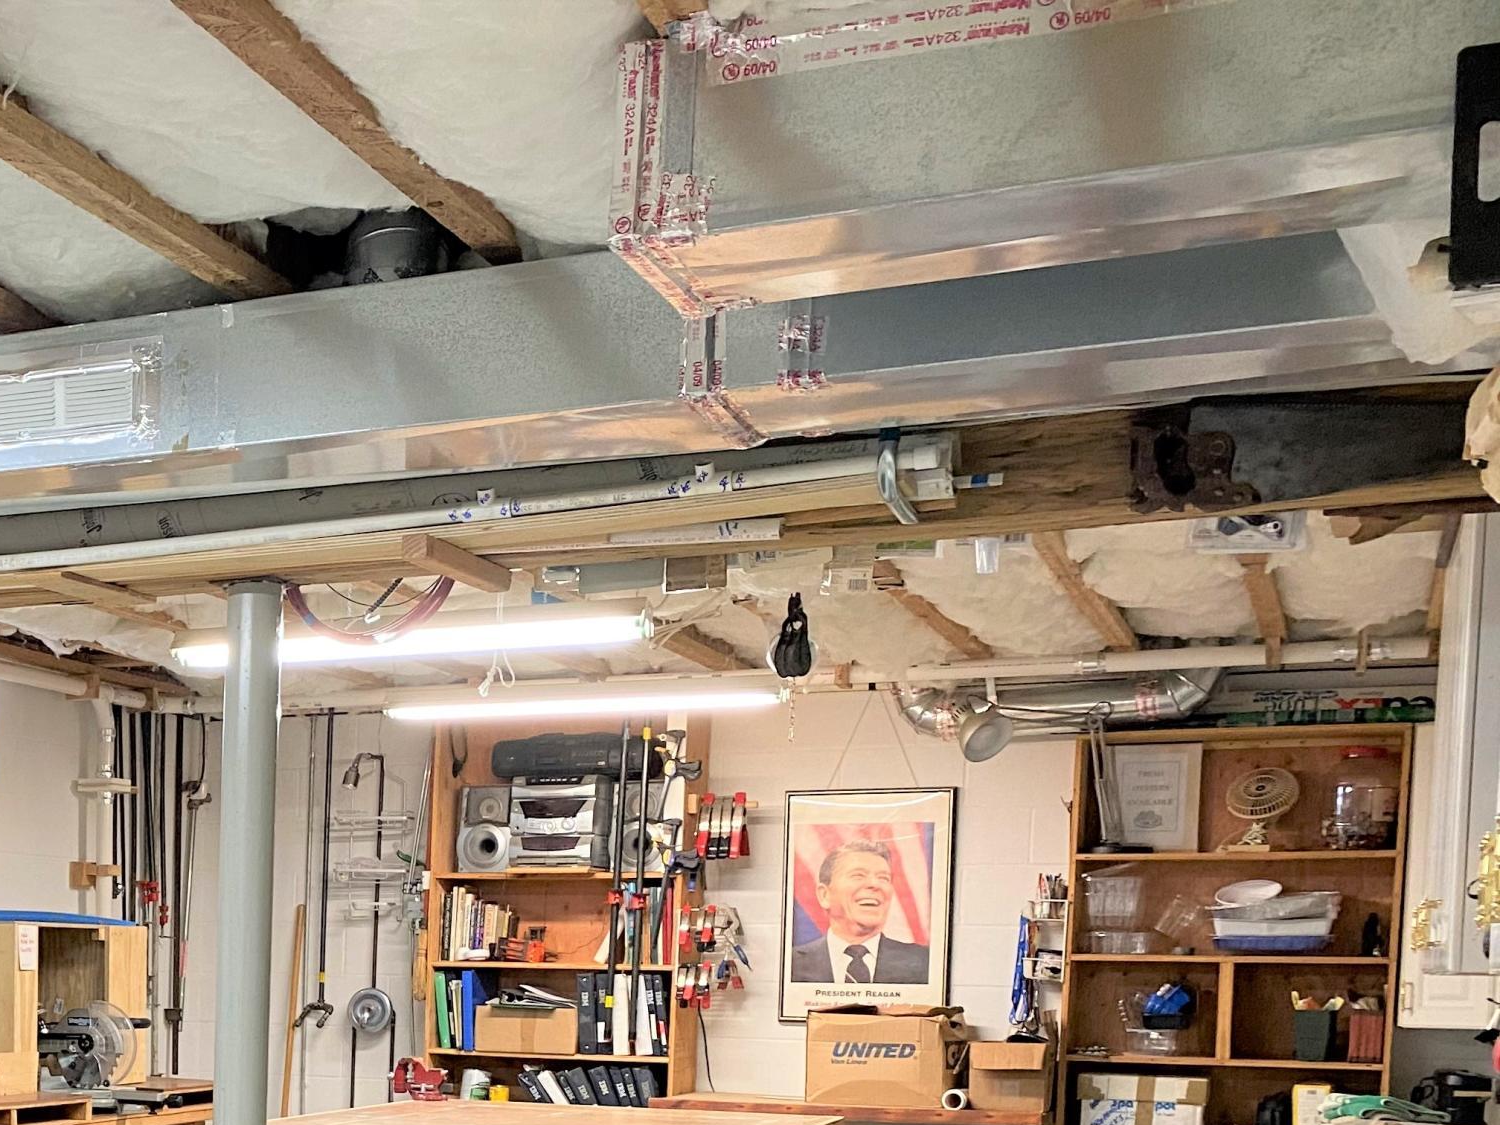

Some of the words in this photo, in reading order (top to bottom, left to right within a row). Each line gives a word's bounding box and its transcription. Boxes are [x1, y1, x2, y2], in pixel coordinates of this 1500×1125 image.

[1074, 7, 1111, 25] 04/09
[924, 30, 961, 46] 324A
[743, 60, 776, 77] 04/09
[624, 103, 636, 136] 324A
[815, 989, 861, 998] PRESIDENT
[865, 990, 901, 998] REAGAN
[832, 1041, 916, 1059] UNITED
